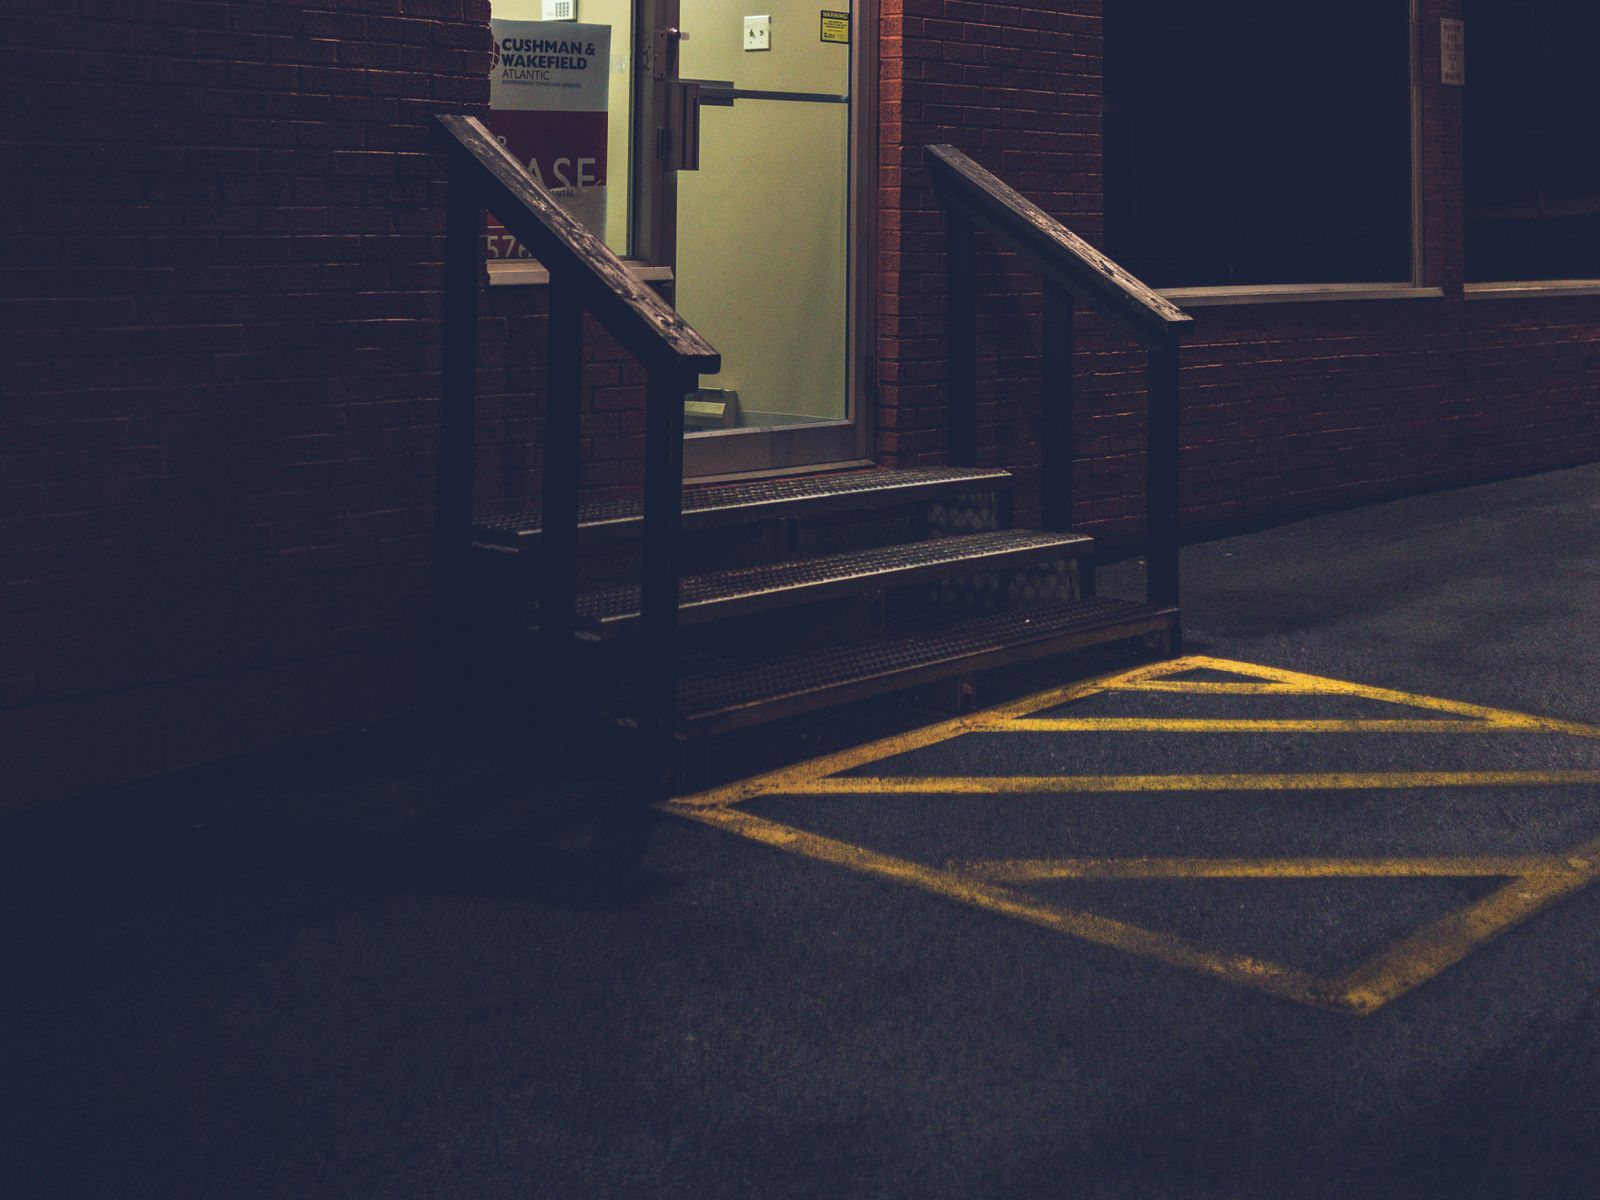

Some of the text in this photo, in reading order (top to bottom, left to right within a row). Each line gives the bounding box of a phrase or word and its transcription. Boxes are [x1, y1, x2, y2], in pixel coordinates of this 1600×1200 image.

[501, 38, 596, 56] CUSHMAN &
[501, 53, 588, 70] WAKEFIELD
[502, 68, 550, 81] ATLANTIC
[526, 157, 597, 188] ASE
